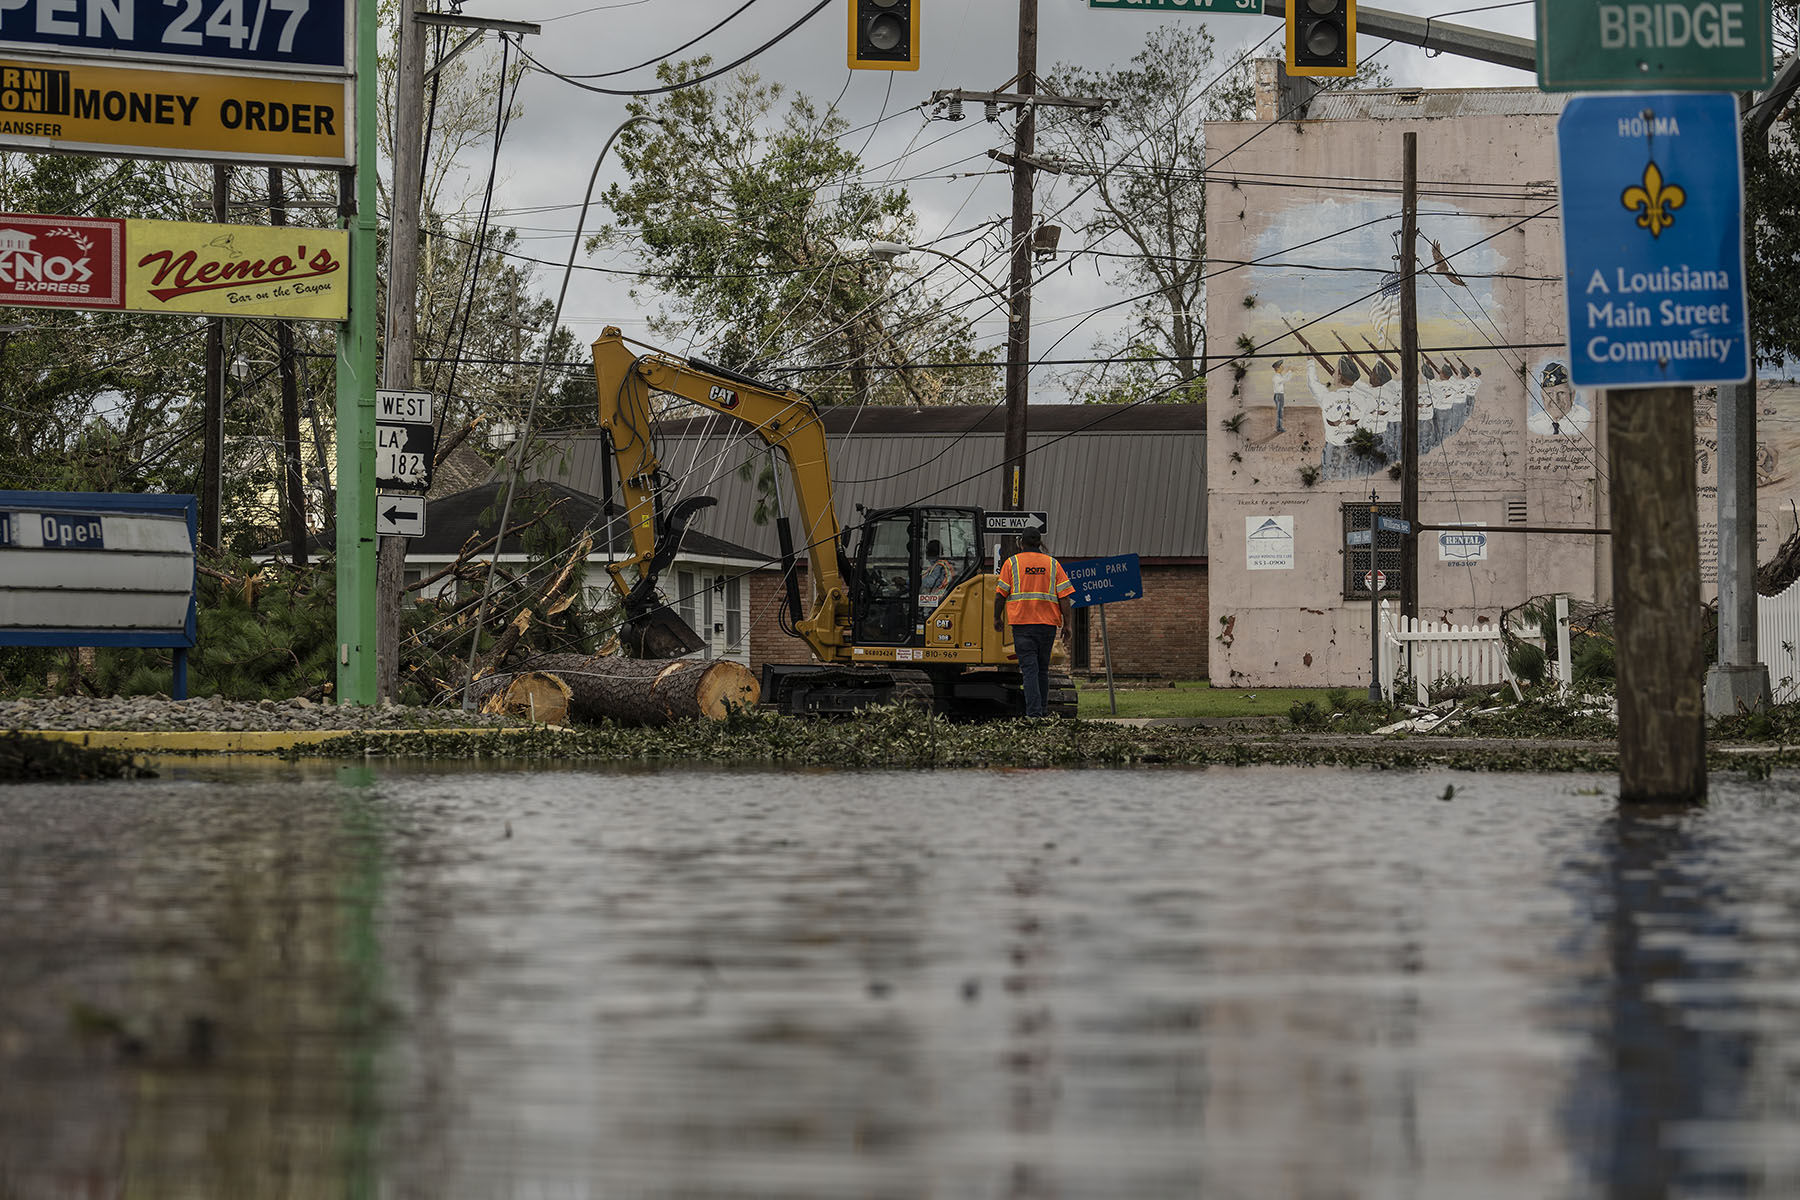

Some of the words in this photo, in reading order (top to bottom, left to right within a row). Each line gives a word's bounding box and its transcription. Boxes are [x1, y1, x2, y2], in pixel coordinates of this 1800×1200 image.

[161, 0, 309, 53] 24/7
[1601, 3, 1745, 48] BRIDGE
[74, 88, 199, 126] MONEY
[220, 99, 336, 136] ORDER
[0, 120, 62, 136] ANSFER
[138, 245, 340, 289] Nemo's
[15, 281, 91, 294] EXPRESS
[1586, 269, 1610, 294] A
[1617, 264, 1729, 293] Louisiana
[226, 292, 252, 304] Bar
[256, 292, 269, 300] on
[273, 286, 290, 298] the
[293, 282, 331, 295] Bayou
[1587, 302, 1651, 328] Main
[1660, 299, 1730, 326] Street
[1587, 333, 1733, 363] Community
[709, 385, 735, 405] CAT
[383, 397, 425, 416] WEST
[379, 430, 399, 448] LA
[391, 454, 419, 475] 182
[43, 516, 102, 546] Open
[989, 519, 1007, 527] ONE
[1009, 519, 1028, 527] WAY
[1446, 536, 1480, 545] RENTAL
[1105, 562, 1128, 574] PARK
[1082, 578, 1114, 591] SCHOOL
[936, 619, 949, 628] CAT
